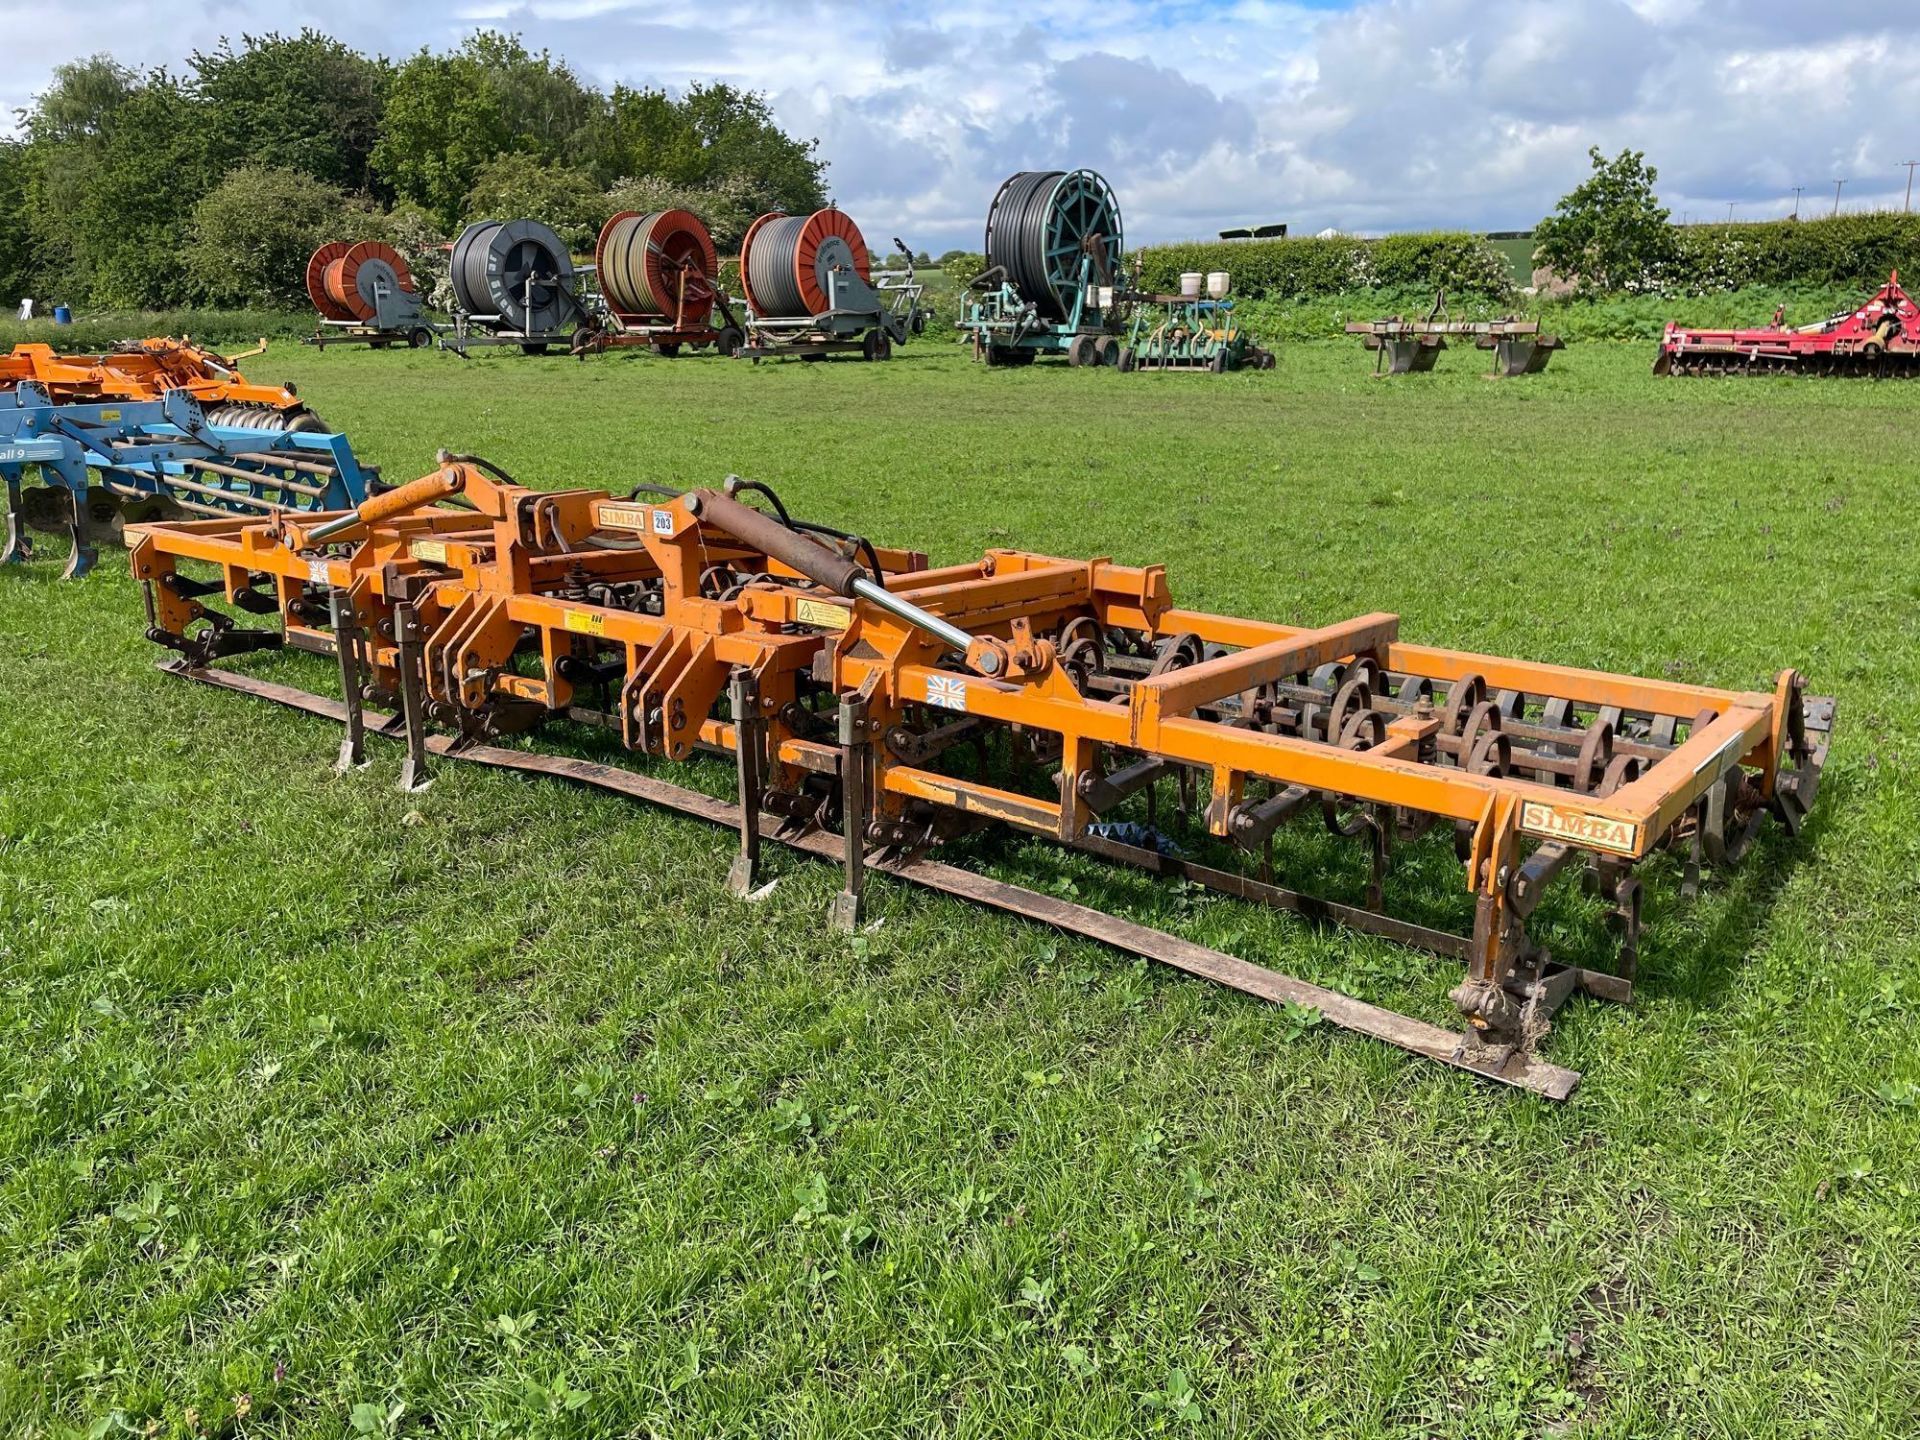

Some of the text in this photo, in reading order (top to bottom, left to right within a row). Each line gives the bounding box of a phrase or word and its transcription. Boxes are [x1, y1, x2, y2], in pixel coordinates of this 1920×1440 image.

[600, 510, 643, 527] SIMBA
[655, 517, 671, 530] 203
[1526, 807, 1630, 845] SIMBA
